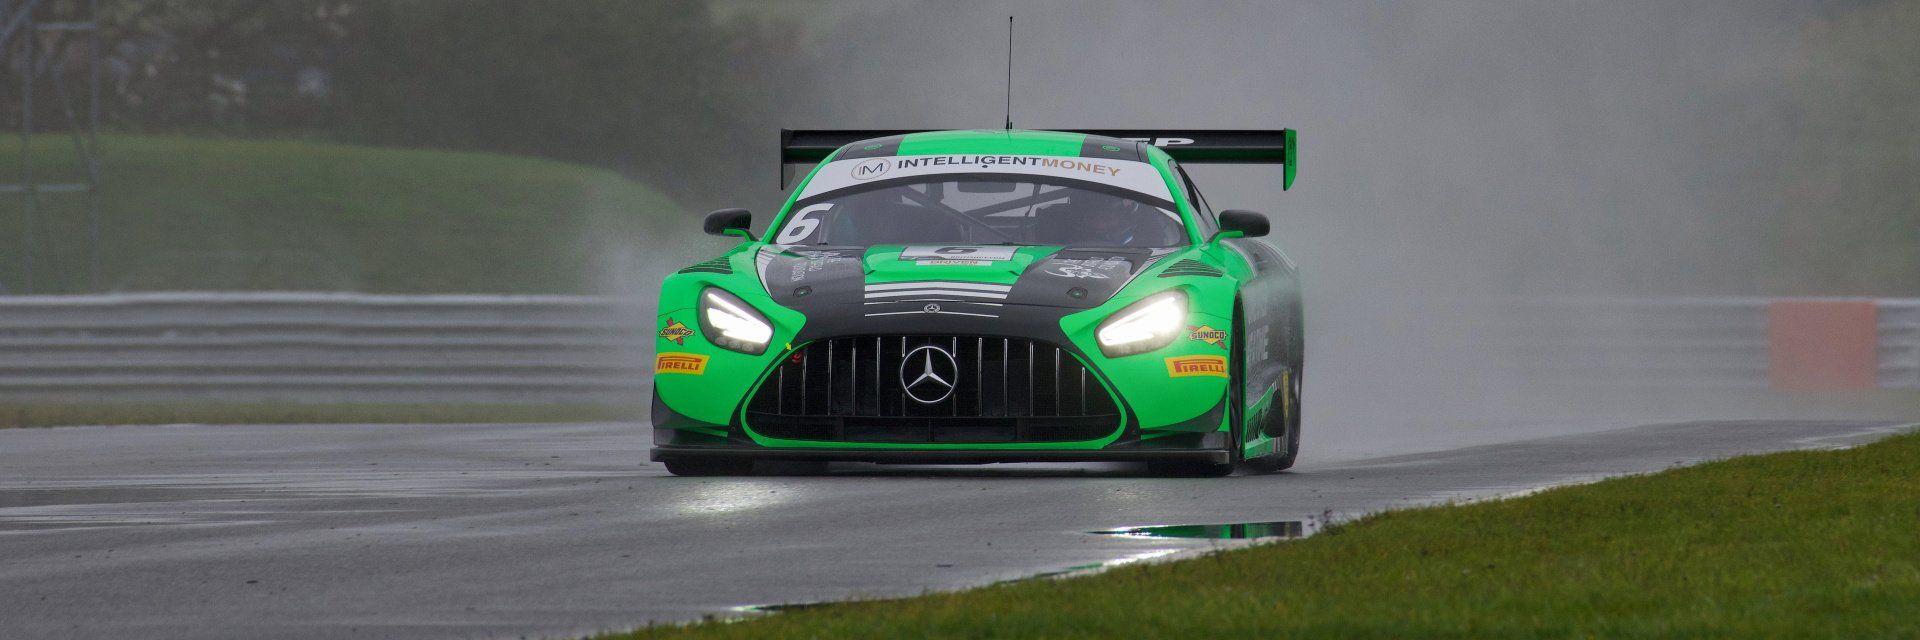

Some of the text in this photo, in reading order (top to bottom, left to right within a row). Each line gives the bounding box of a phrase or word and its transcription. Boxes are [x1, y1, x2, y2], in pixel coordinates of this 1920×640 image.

[776, 202, 835, 245] 6
[1190, 331, 1225, 339] SUNOCO
[657, 356, 703, 371] PIRELLI
[1174, 358, 1225, 373] PIRELLI
